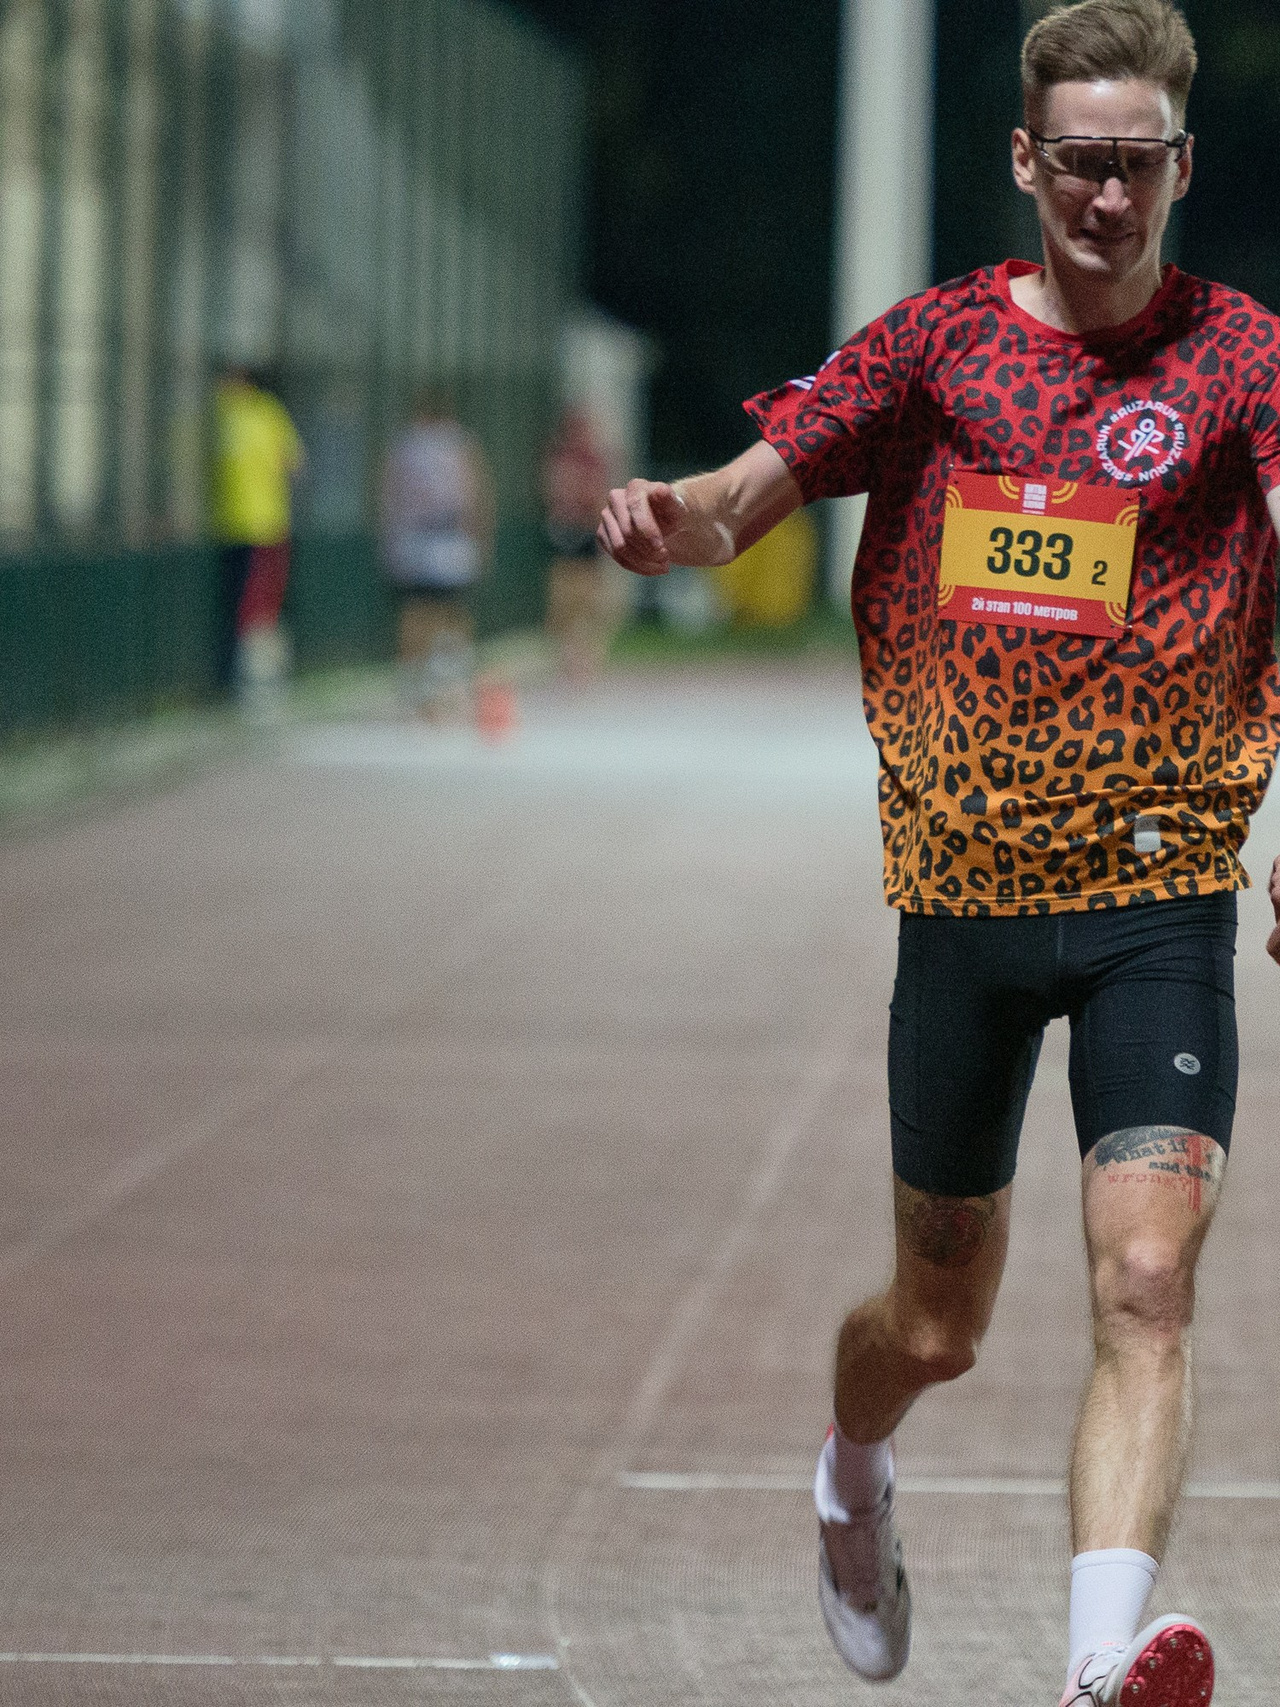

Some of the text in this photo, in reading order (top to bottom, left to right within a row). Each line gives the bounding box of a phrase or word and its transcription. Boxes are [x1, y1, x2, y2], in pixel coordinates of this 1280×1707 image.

[987, 527, 1108, 586] 333 2
[971, 597, 1079, 621] 2й этап 100 метров
